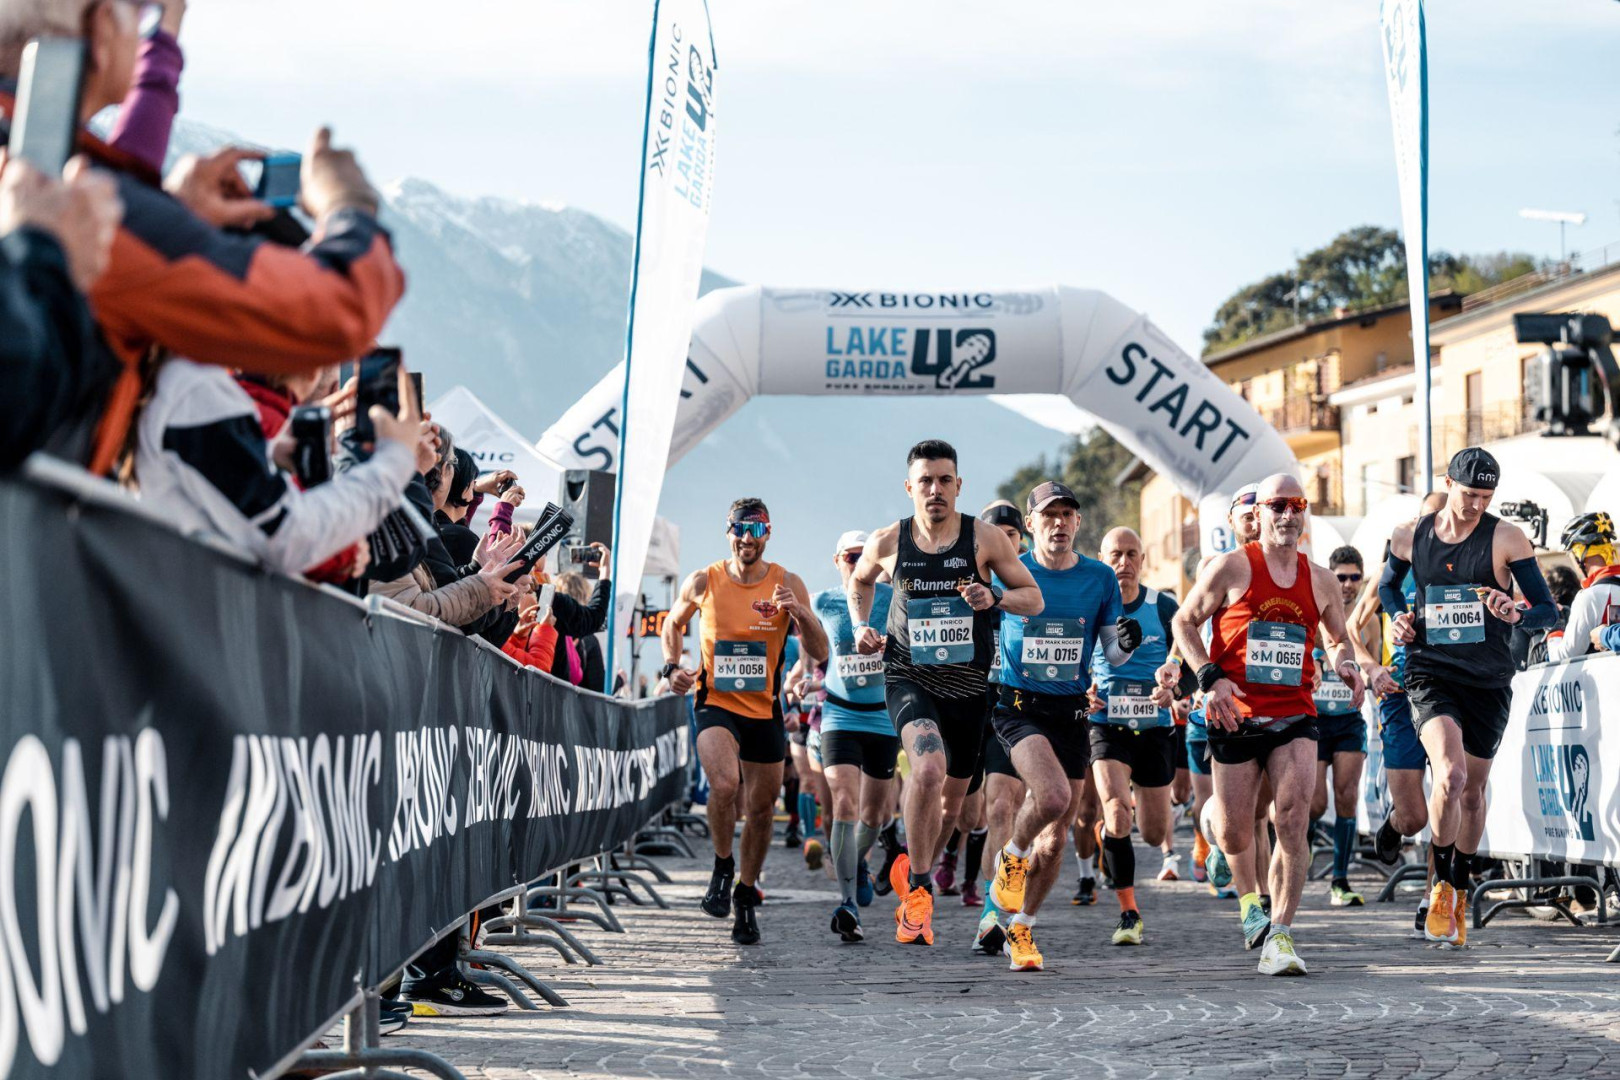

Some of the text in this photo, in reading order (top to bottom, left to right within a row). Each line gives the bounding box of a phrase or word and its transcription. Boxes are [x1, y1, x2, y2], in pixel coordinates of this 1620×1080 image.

[826, 326, 907, 355] LAKE
[910, 328, 997, 389] 42
[826, 360, 907, 379] GARDA
[1105, 342, 1250, 464] START
[1438, 612, 1482, 625] M 0064
[923, 628, 970, 643] M 0062
[1036, 648, 1079, 661] M 0715
[1261, 651, 1302, 666] M 0655
[726, 664, 764, 675] M 0058
[847, 661, 883, 674] M 0490
[1331, 689, 1352, 699] 0535
[1120, 704, 1155, 716] M 0419
[1531, 744, 1556, 782] LAKE
[1556, 744, 1596, 841] 42
